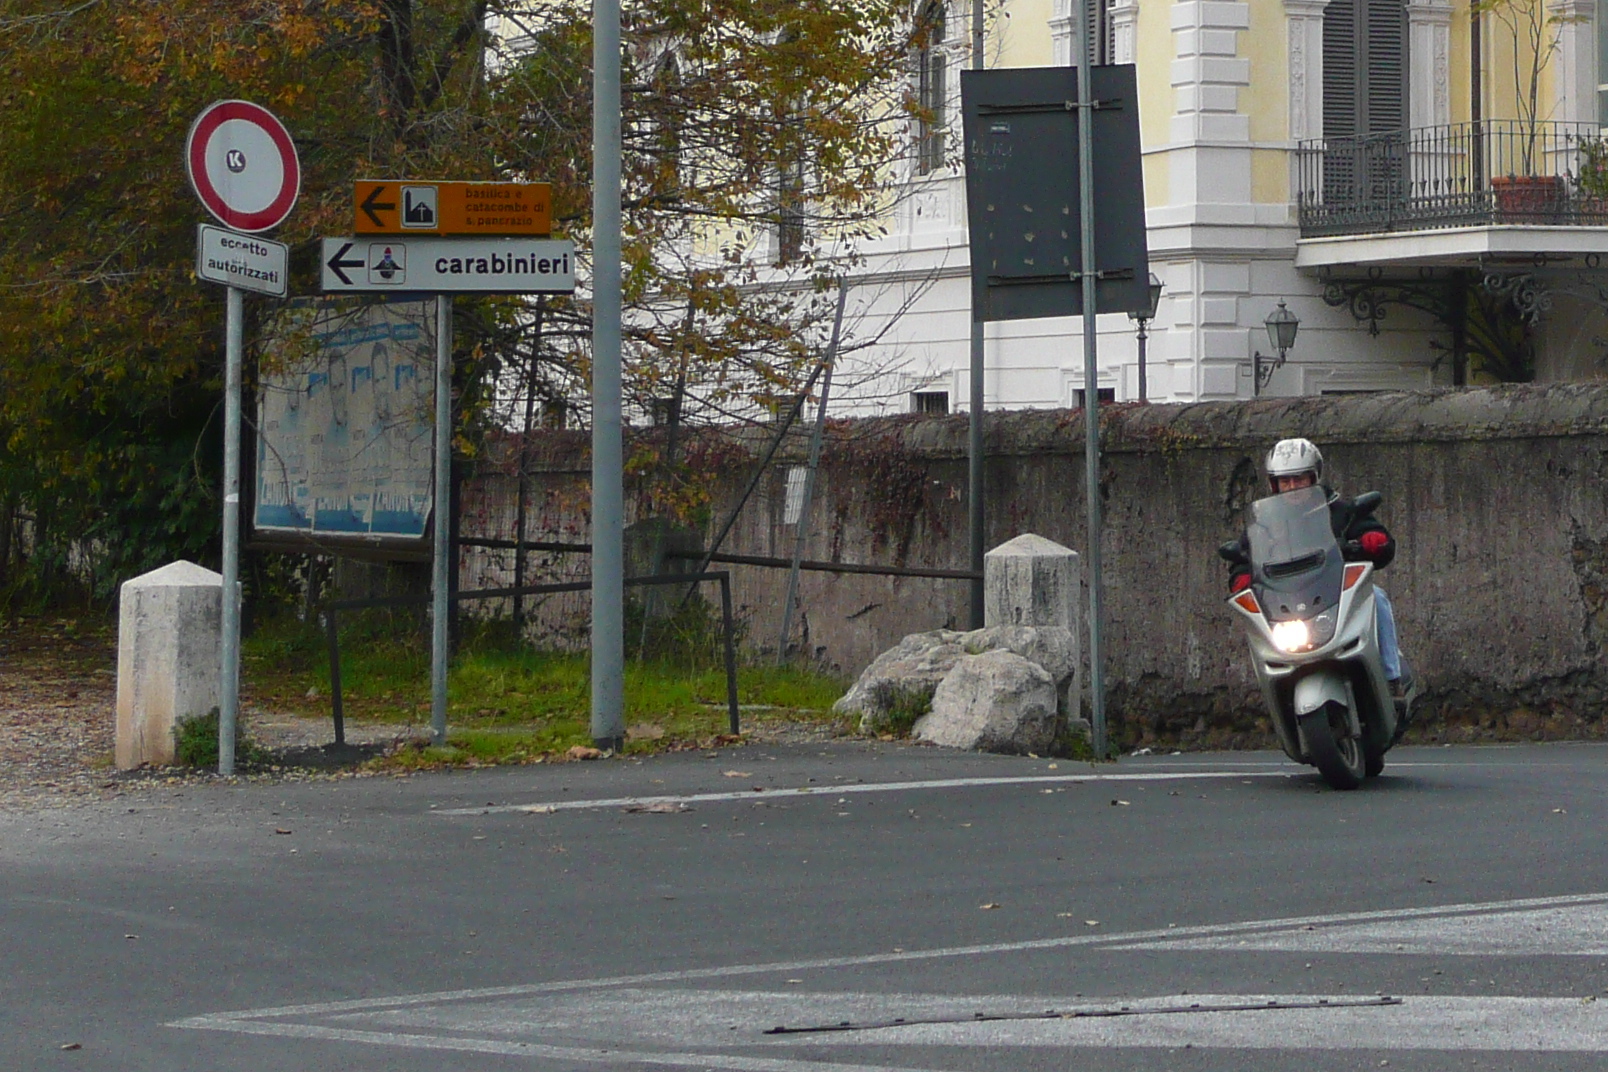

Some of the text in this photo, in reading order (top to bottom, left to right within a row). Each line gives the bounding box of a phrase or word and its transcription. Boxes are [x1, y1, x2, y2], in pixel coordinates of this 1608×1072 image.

[229, 152, 242, 167] K
[465, 188, 522, 199] basilica e
[465, 201, 544, 213] catacombe di
[220, 237, 268, 257] eccetto
[208, 258, 279, 283] autorizzati
[435, 252, 568, 274] carabinieri
